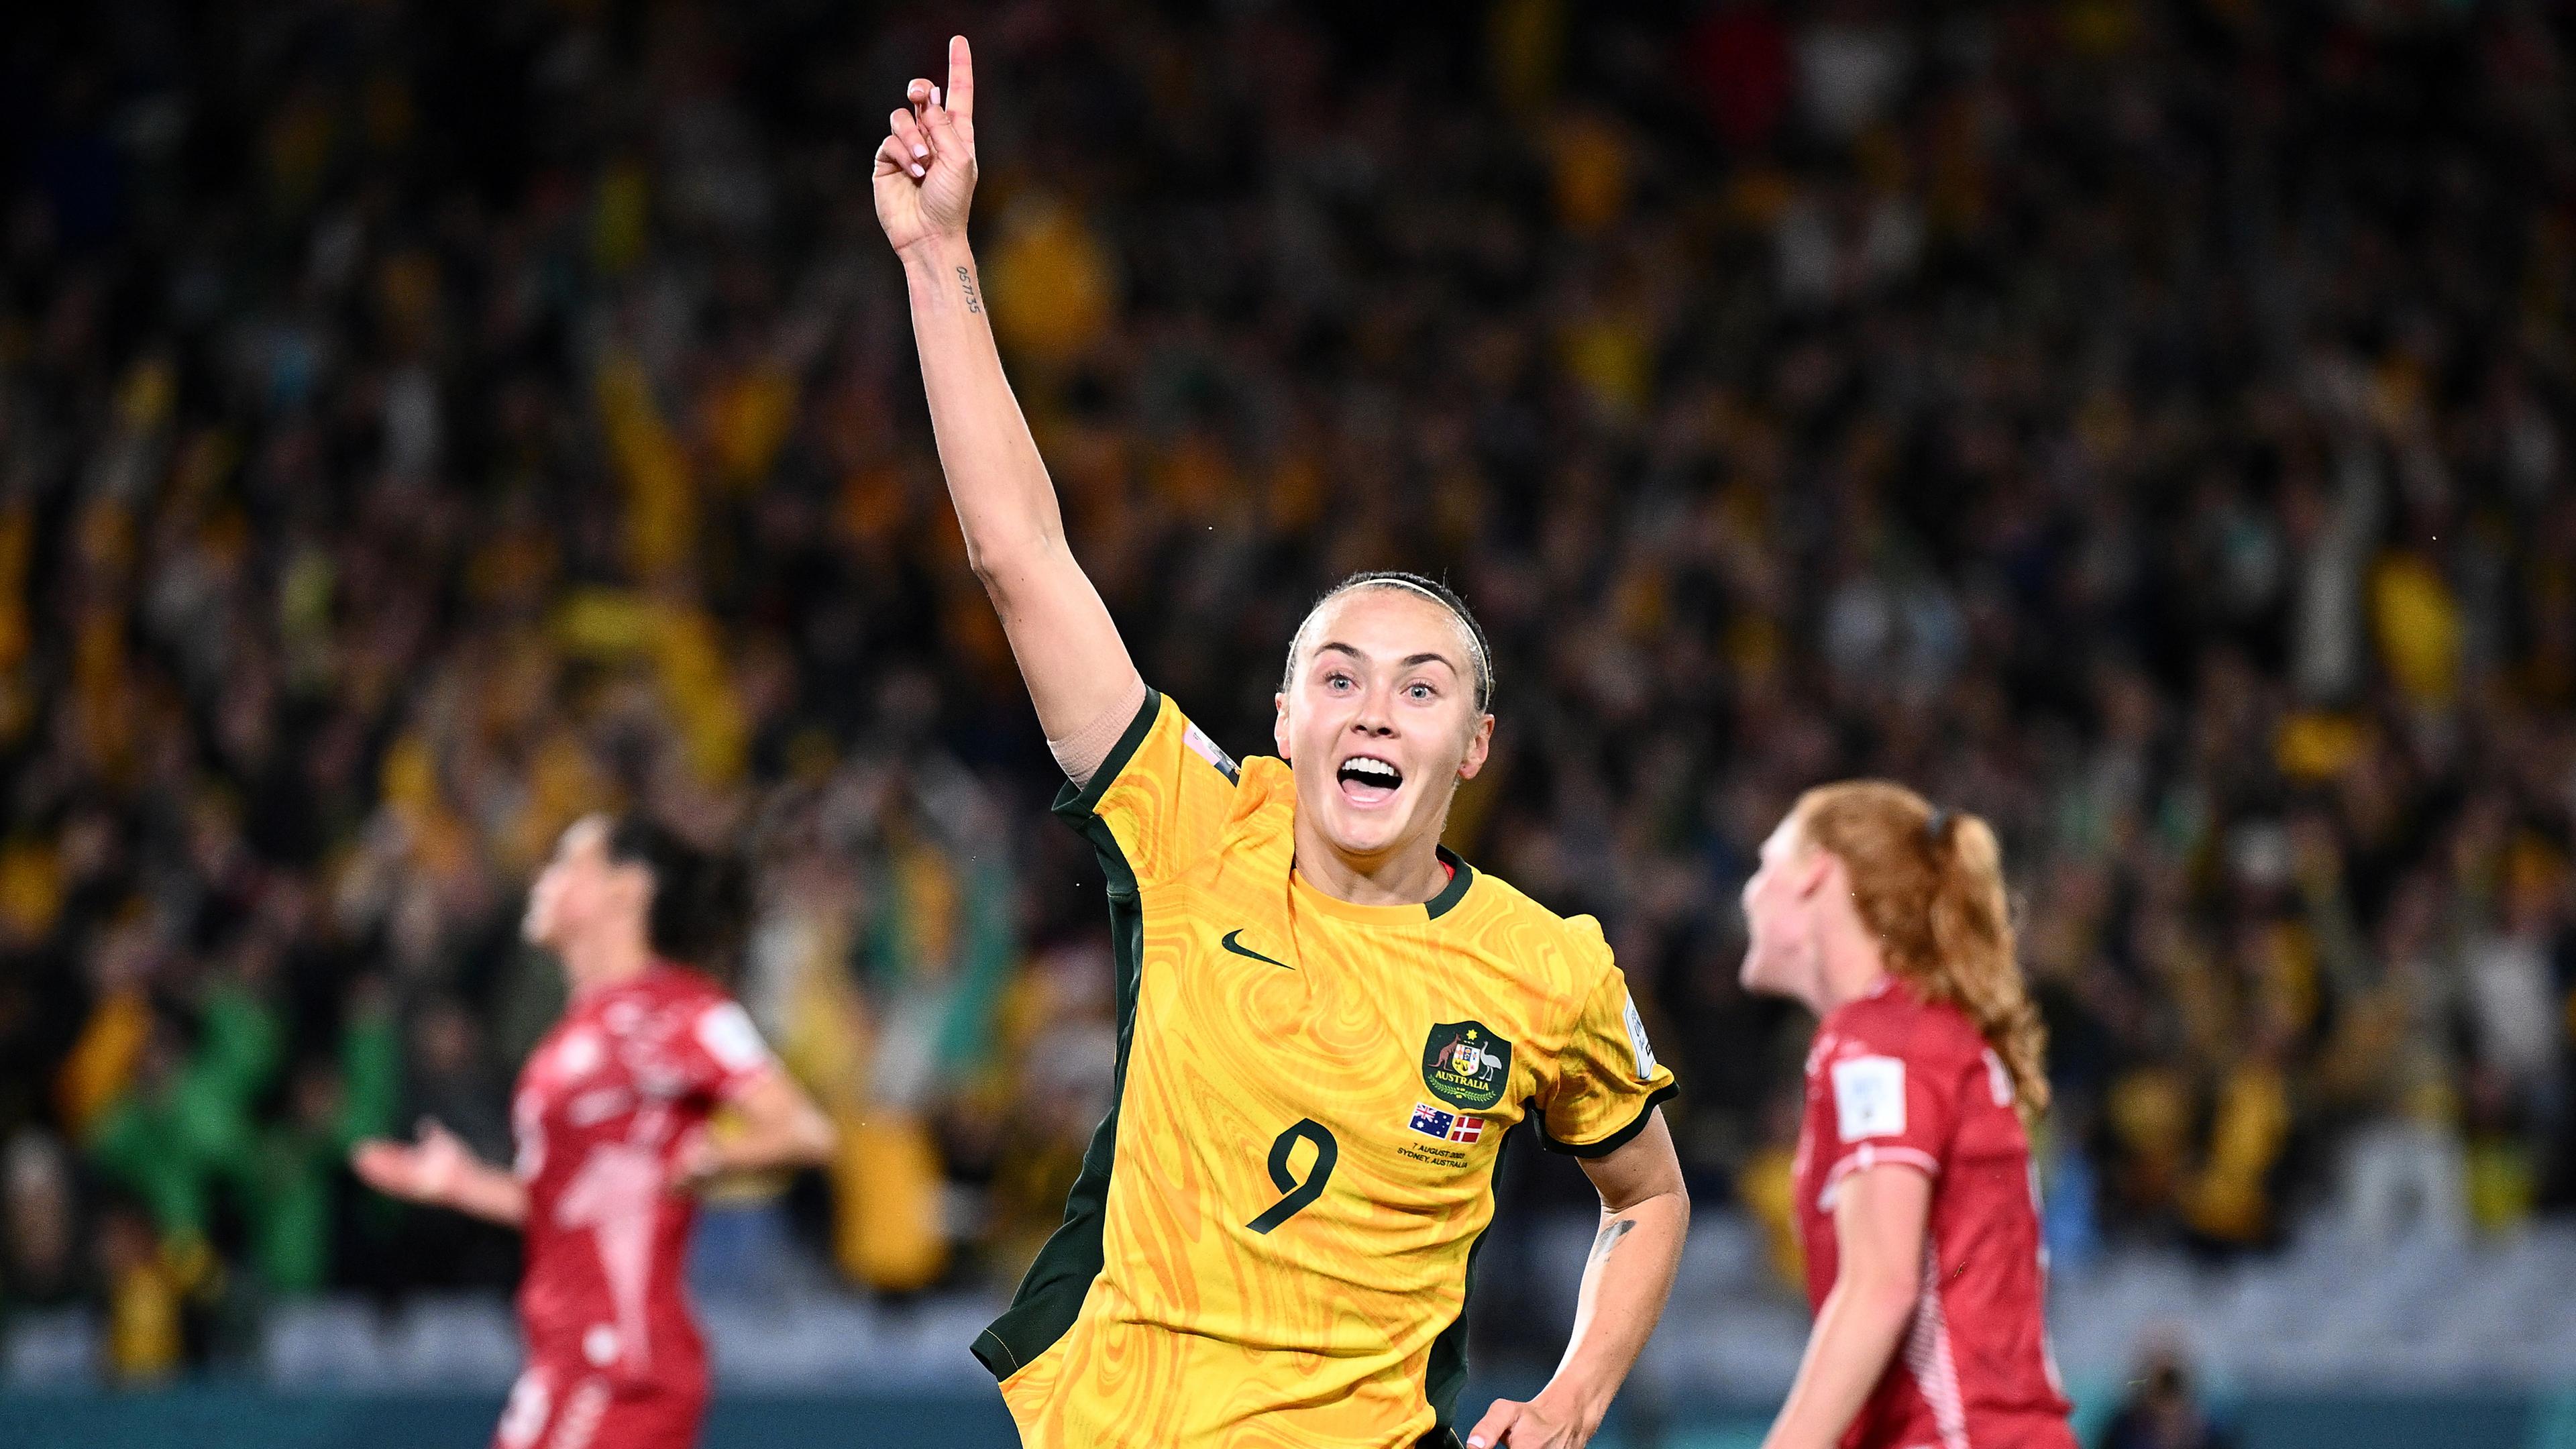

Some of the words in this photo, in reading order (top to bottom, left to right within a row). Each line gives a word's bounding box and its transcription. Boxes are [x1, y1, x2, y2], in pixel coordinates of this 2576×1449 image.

[1435, 1070, 1489, 1091] AUSTRALIA
[1397, 1147, 1430, 1163] SYDNEY,
[1431, 1158, 1468, 1168] AUSTRALIA
[1418, 1145, 1450, 1157] AUGUST
[1245, 1118, 1338, 1234] 9
